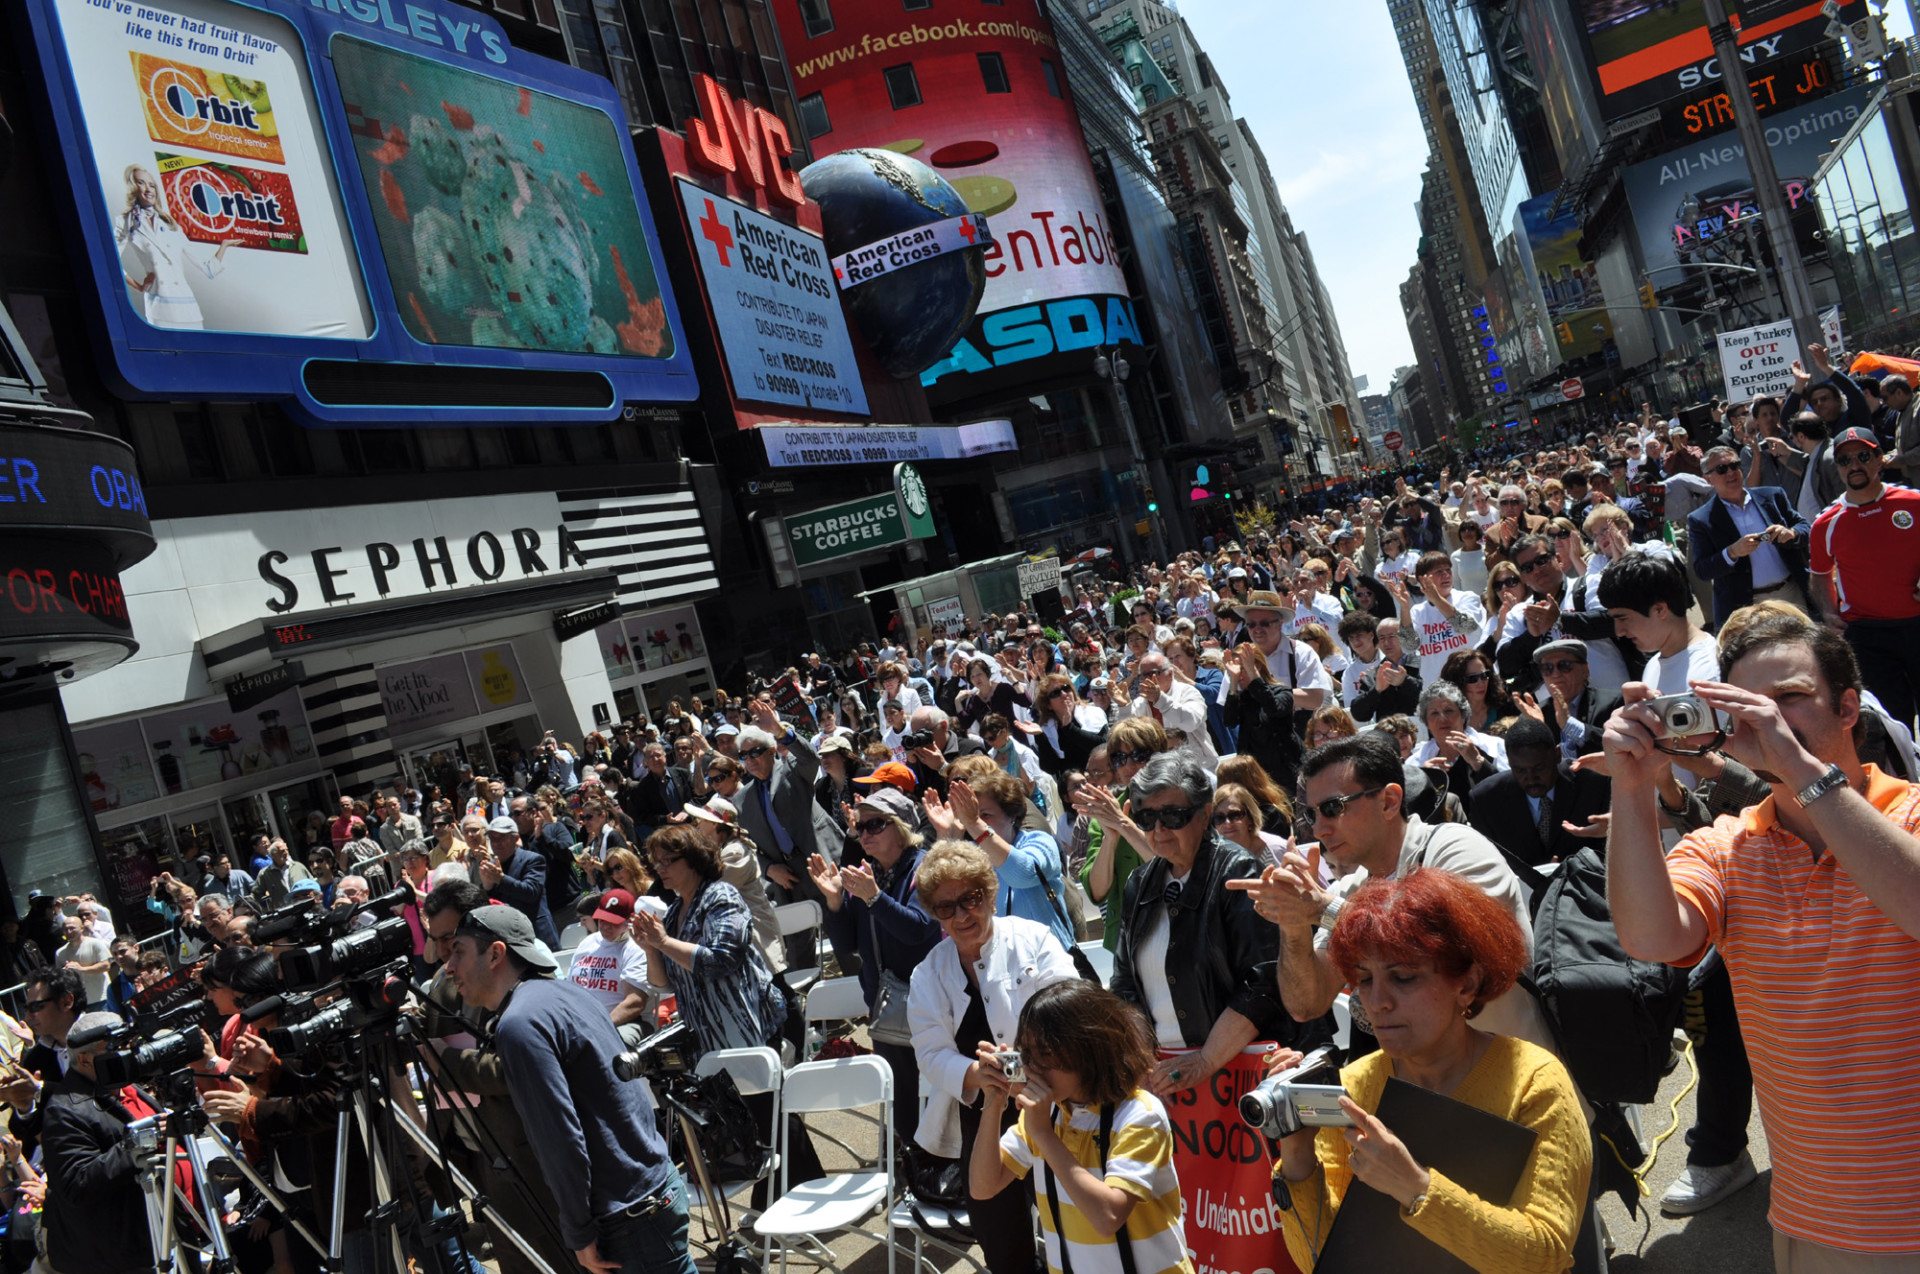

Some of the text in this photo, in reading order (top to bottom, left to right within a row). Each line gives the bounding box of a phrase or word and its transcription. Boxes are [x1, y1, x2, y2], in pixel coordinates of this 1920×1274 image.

[125, 21, 152, 40] like
[157, 30, 183, 47] this
[188, 37, 219, 57] from
[137, 7, 177, 26] never
[180, 17, 206, 34] had
[210, 25, 239, 44] fruit
[243, 33, 278, 53] flavor
[165, 84, 260, 130] Orbit
[207, 130, 243, 146] tropical
[686, 72, 806, 206] JVC
[1764, 104, 1861, 148] Optima
[163, 159, 185, 171] NEW!
[190, 182, 285, 225] Orbit
[733, 209, 822, 270] American
[845, 228, 935, 269] American
[738, 242, 831, 300] Red Cross
[847, 242, 942, 284] Red Cross
[736, 290, 830, 330] CONTRIBUTE TO JAPAN
[755, 318, 824, 349] DISASTER RELIEF
[1723, 326, 1793, 348] Keep Turkey
[758, 347, 837, 380] Text REDCROSS
[1739, 355, 1785, 372] of the
[1740, 342, 1779, 360] OUT
[753, 372, 765, 391] to
[765, 373, 801, 396] 90999
[811, 383, 840, 402] donate
[1744, 381, 1788, 397] Union
[784, 431, 918, 446] CONTRIBUTE TO JAPAN DISASTER RELIEF
[779, 450, 799, 464] Text
[800, 448, 853, 463] REDCROSS
[791, 503, 898, 541] STARBUCKS
[815, 523, 883, 551] COFFEE
[257, 523, 589, 613] SEPHORA
[1020, 570, 1060, 585] SURVIVED
[558, 605, 611, 631] SEPHORA
[1422, 620, 1453, 636] TURKE
[1436, 628, 1454, 642] THE
[230, 667, 289, 696] SEPHORA
[384, 673, 414, 695] Get
[605, 896, 619, 910] P
[576, 954, 618, 970] AMERICA
[579, 967, 607, 979] IS THE
[151, 981, 201, 1012] PLANNE
